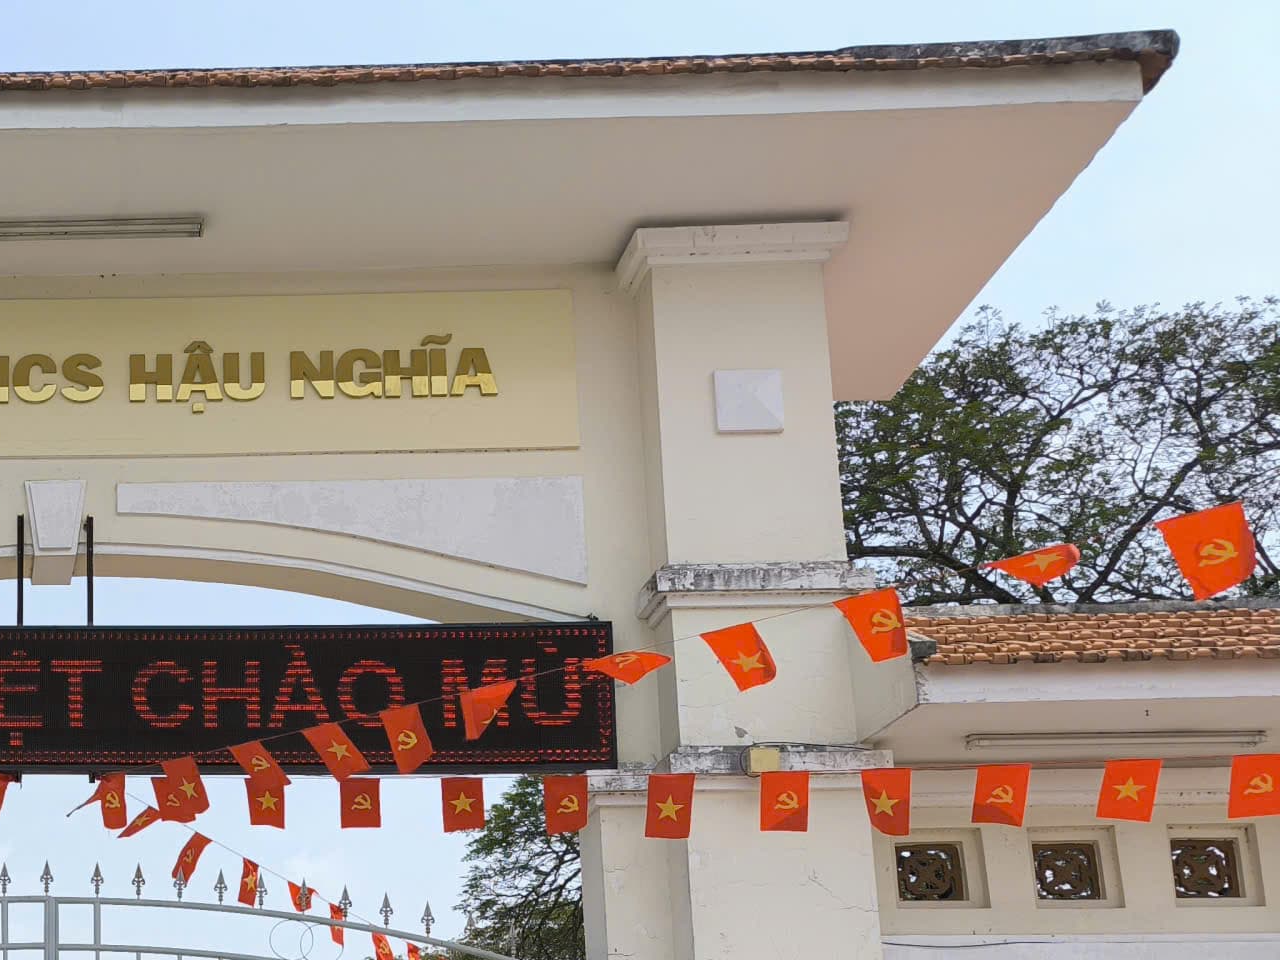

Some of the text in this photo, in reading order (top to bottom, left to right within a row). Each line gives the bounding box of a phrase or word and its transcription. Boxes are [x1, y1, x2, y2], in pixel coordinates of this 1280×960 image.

[129, 340, 265, 414] HẬU
[290, 333, 498, 399] NGHĨA
[131, 644, 406, 728] CHÀO
